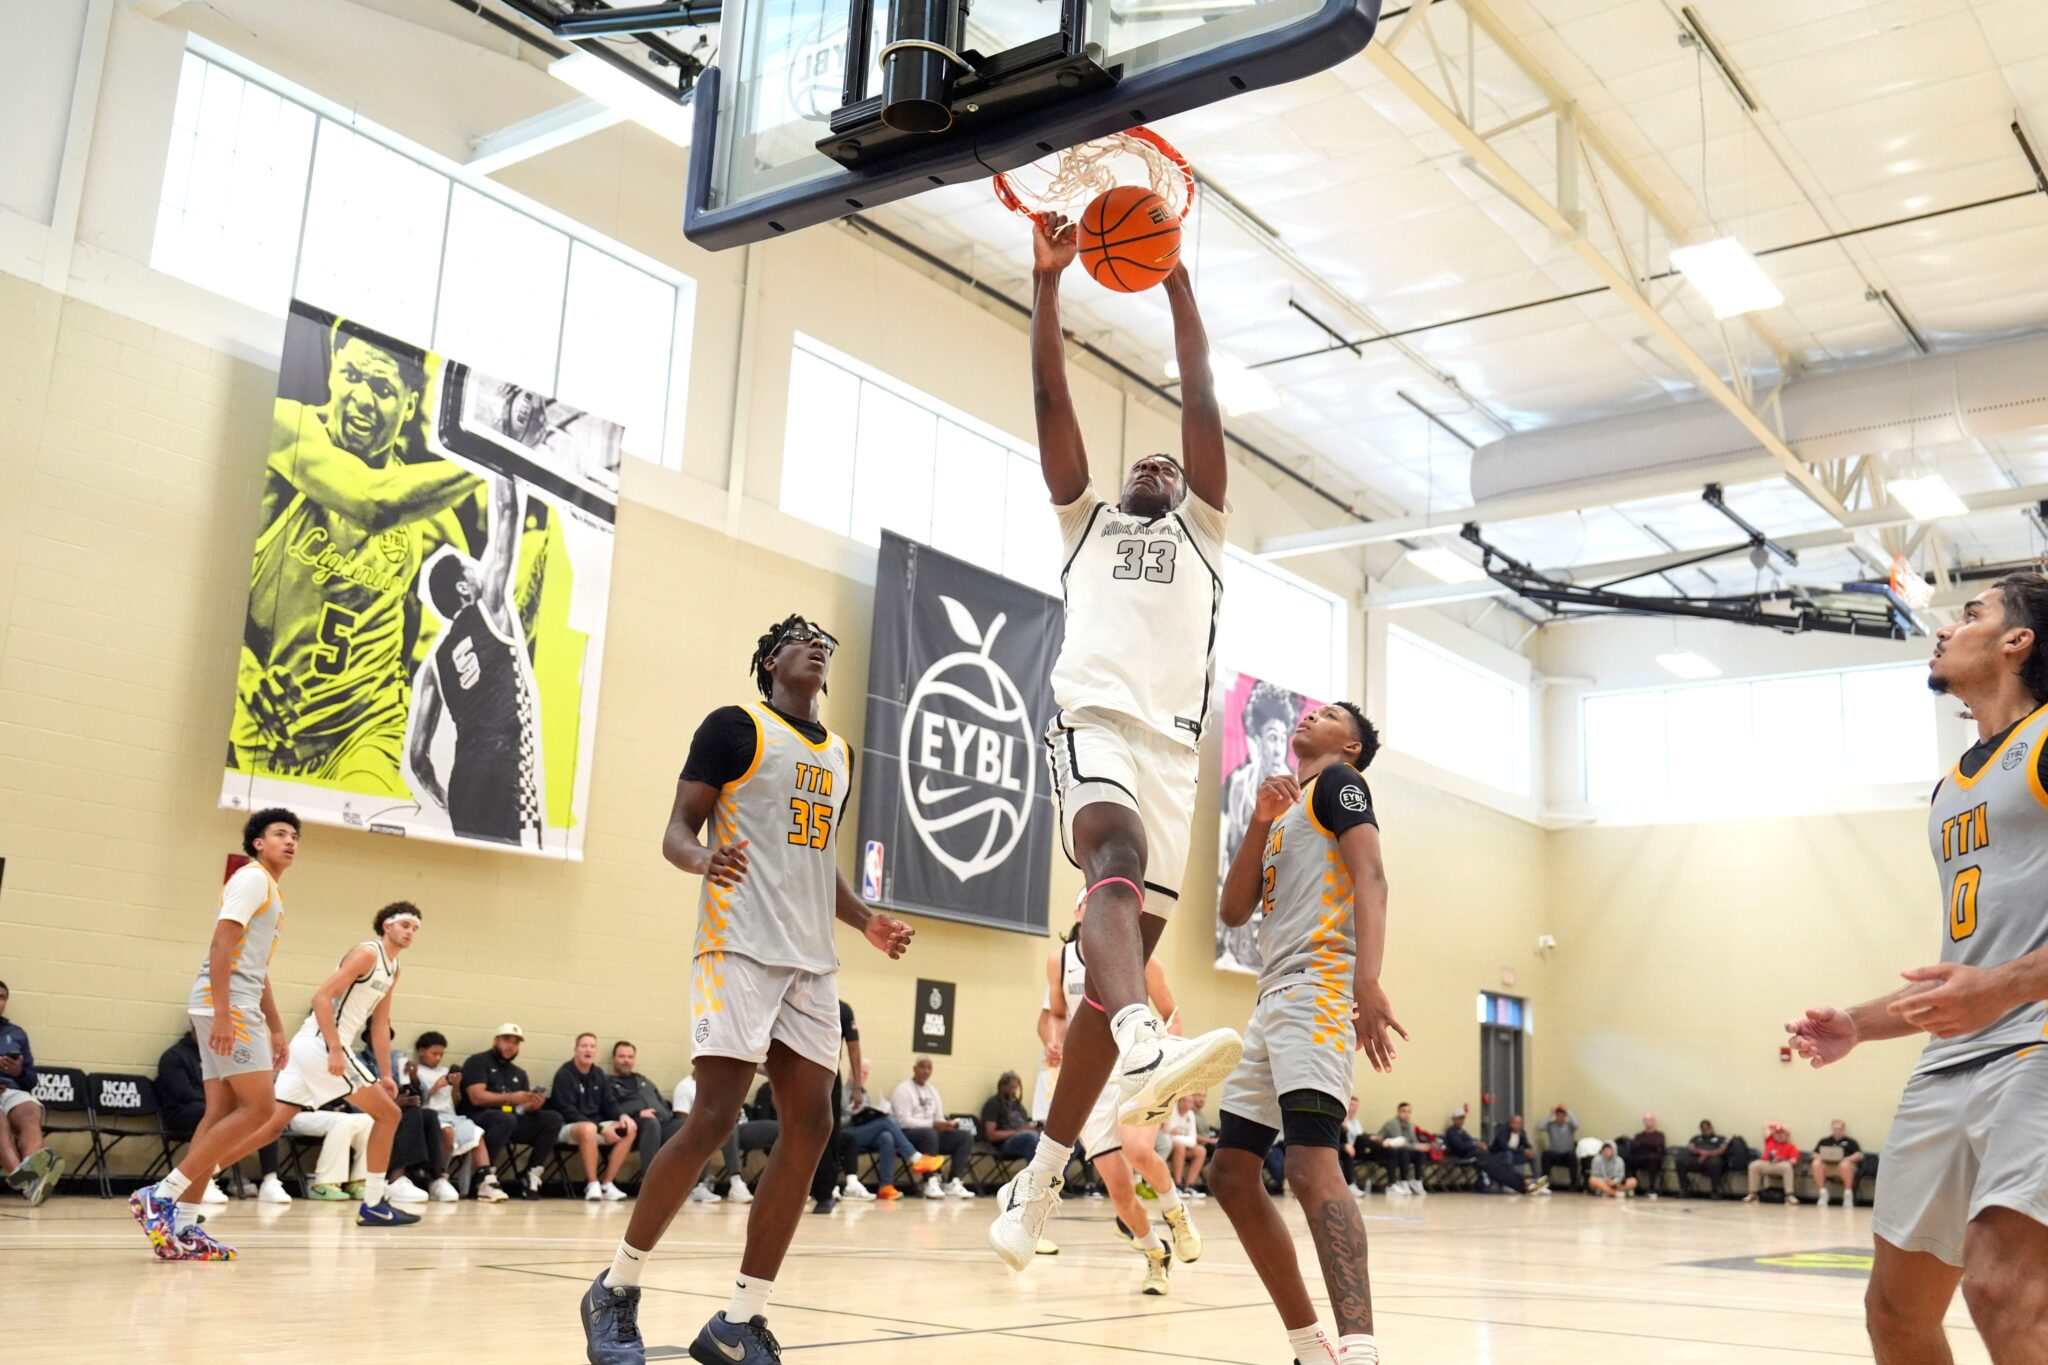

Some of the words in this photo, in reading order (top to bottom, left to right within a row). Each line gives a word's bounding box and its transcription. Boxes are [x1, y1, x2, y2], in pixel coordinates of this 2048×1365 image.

[383, 533, 406, 549] EYBL
[1112, 540, 1177, 584] 33
[310, 601, 361, 681] 5
[920, 709, 1021, 791] EYBL
[796, 761, 833, 798] TTN
[1342, 792, 1364, 804] EYBL
[787, 797, 834, 852] 35
[1942, 801, 1989, 864] TTN
[1950, 864, 1982, 944] 0
[31, 1086, 75, 1102] COACH
[37, 1073, 71, 1088] NCAA
[102, 1080, 138, 1095] NCAA
[100, 1093, 141, 1108] COACH
